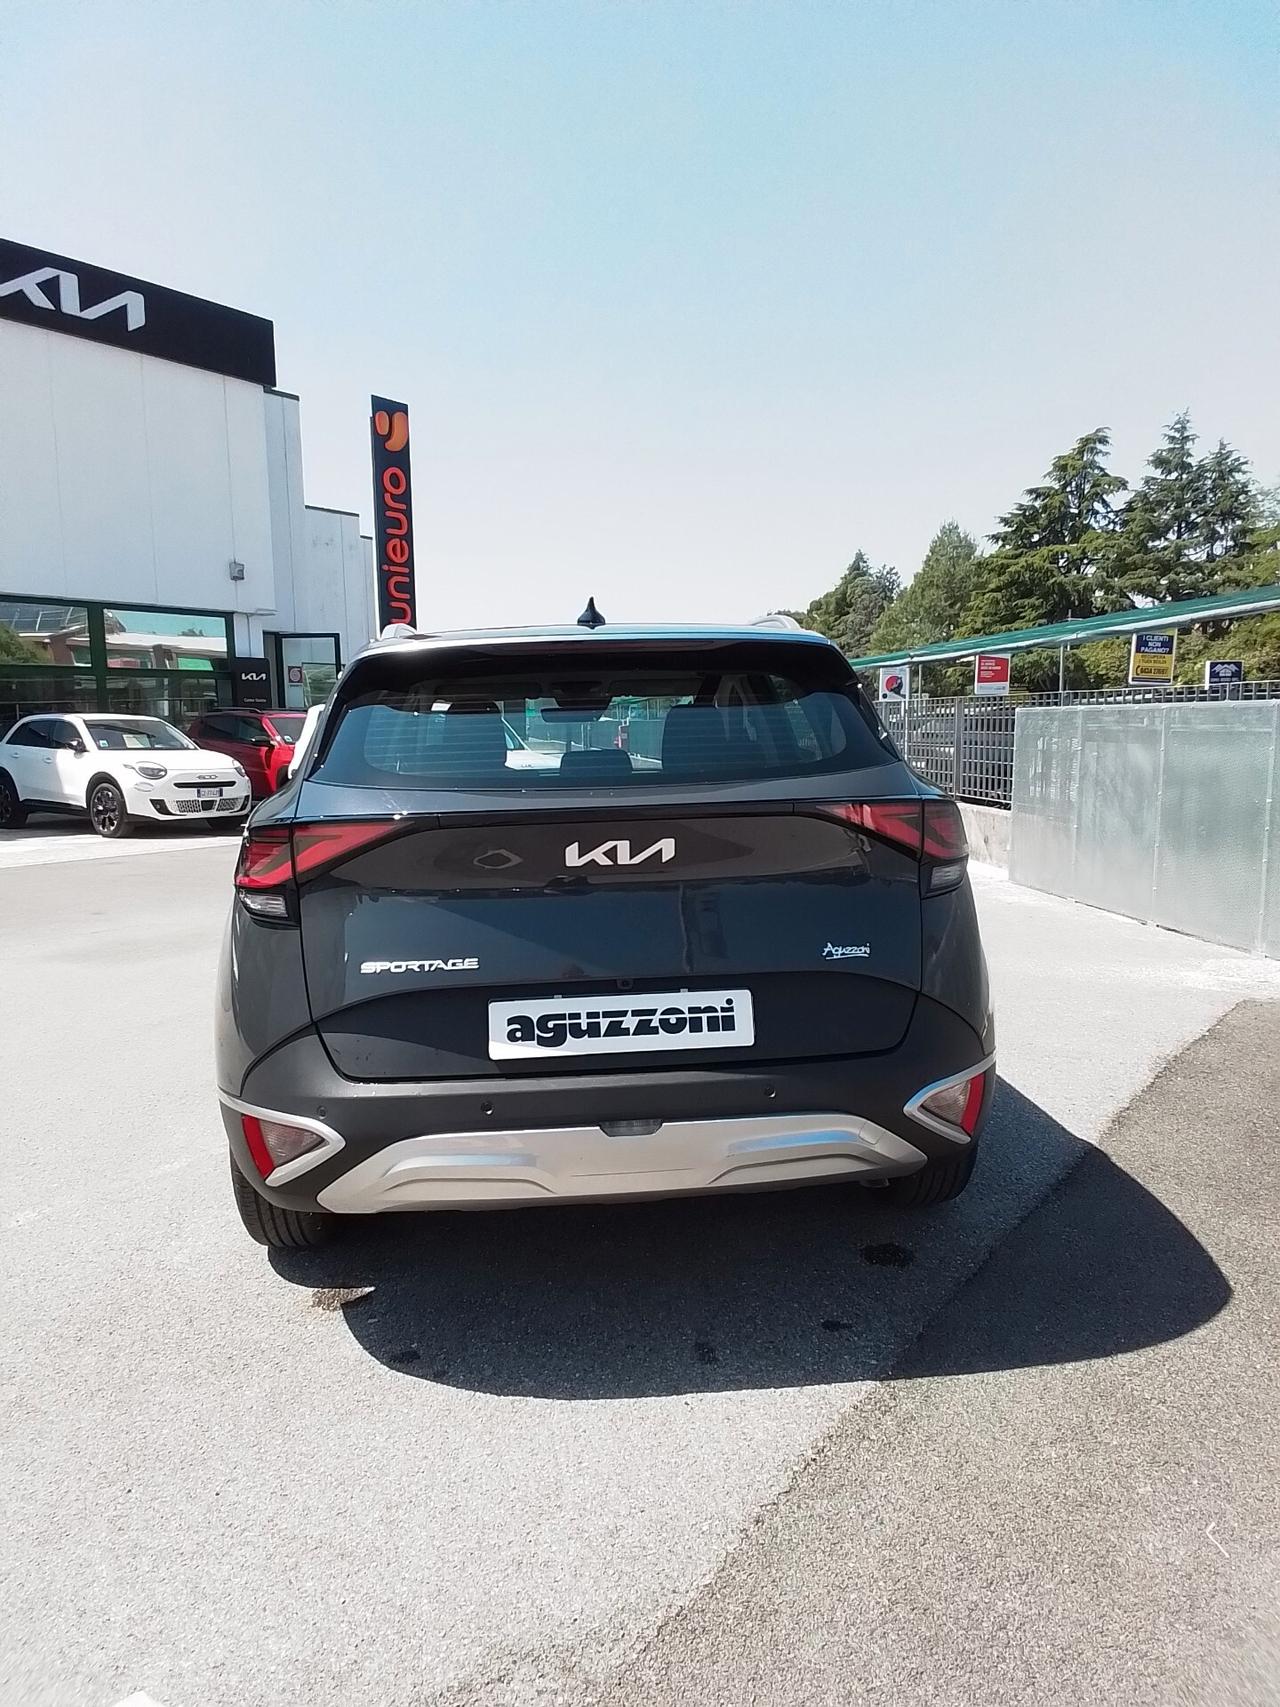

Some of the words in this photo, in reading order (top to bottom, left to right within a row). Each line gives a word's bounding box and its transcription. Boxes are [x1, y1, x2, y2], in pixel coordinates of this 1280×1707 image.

[382, 466, 412, 624] unieuro
[360, 958, 479, 974] SPORTAGE
[506, 997, 736, 1048] aguzzoni
